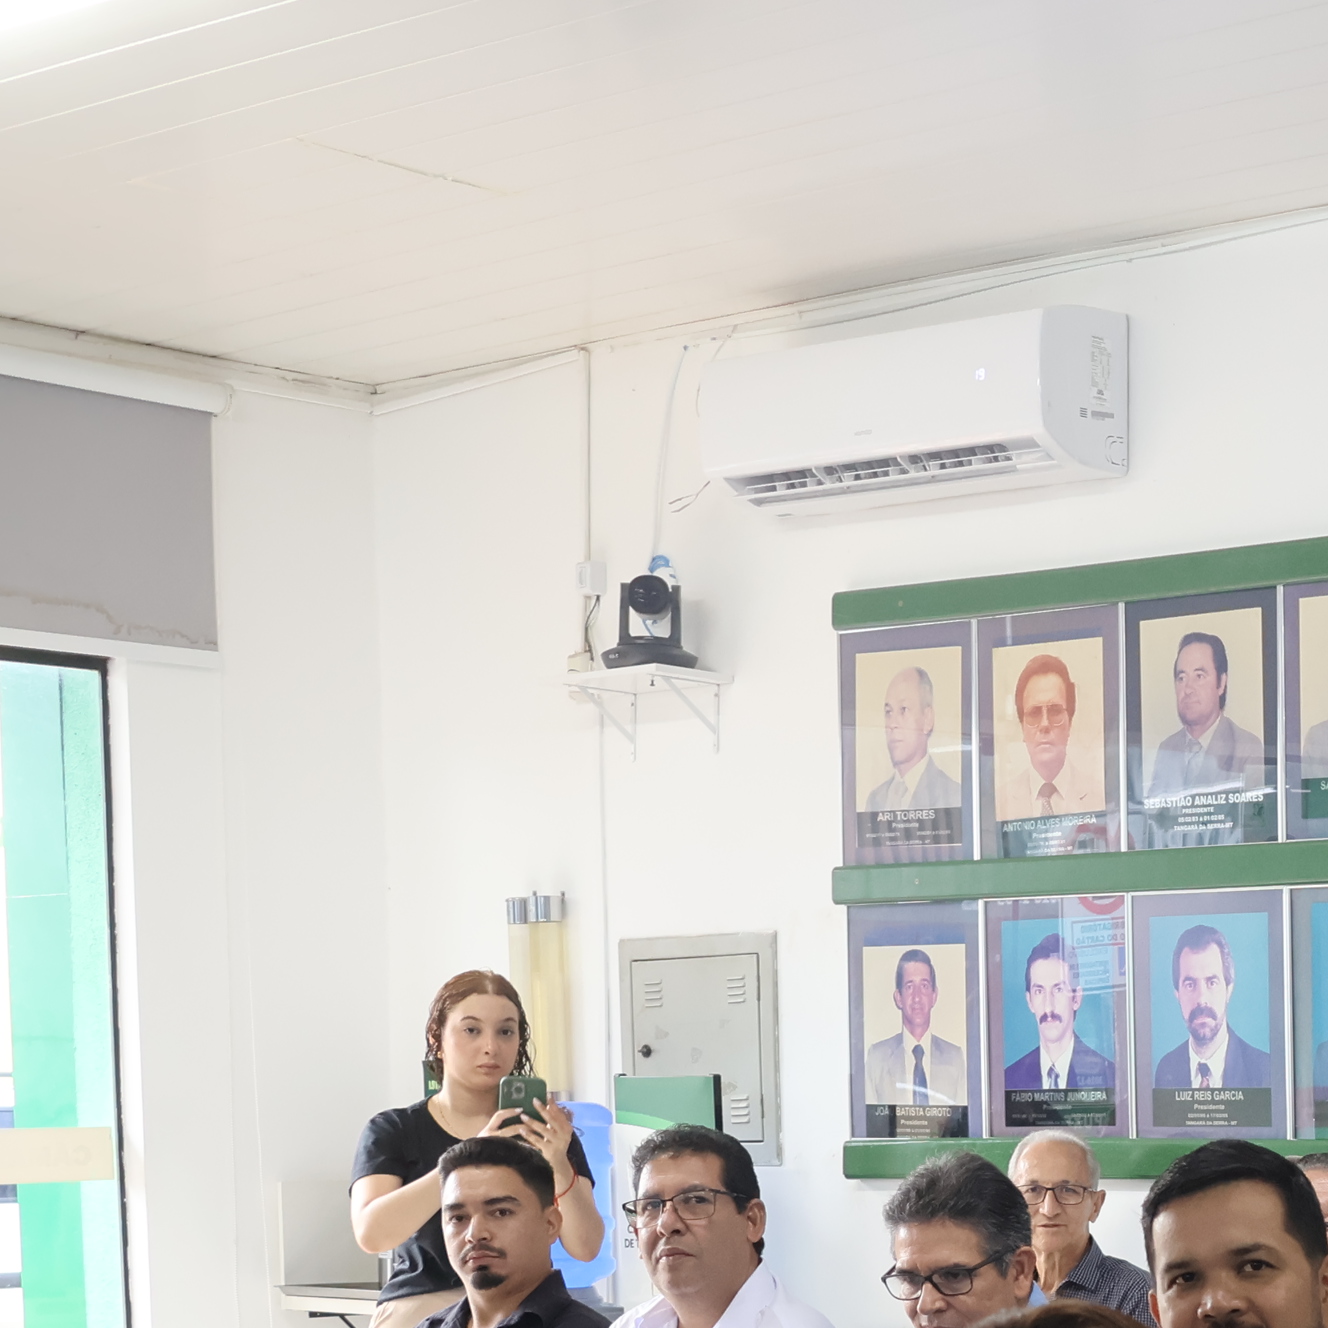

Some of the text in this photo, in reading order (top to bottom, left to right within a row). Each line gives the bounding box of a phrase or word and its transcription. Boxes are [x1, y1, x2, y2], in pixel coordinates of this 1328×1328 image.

[1194, 794, 1227, 806] ANALIZ
[1228, 791, 1264, 804] SOARES
[877, 809, 936, 823] ARI TORRES
[1034, 817, 1060, 831] ALVES
[1033, 1091, 1065, 1102] MARTINS
[1066, 1090, 1108, 1102] JUNQUEIRA
[1175, 1090, 1244, 1101] LUIZ REIS GARCIA
[895, 1106, 924, 1117] BATISTA
